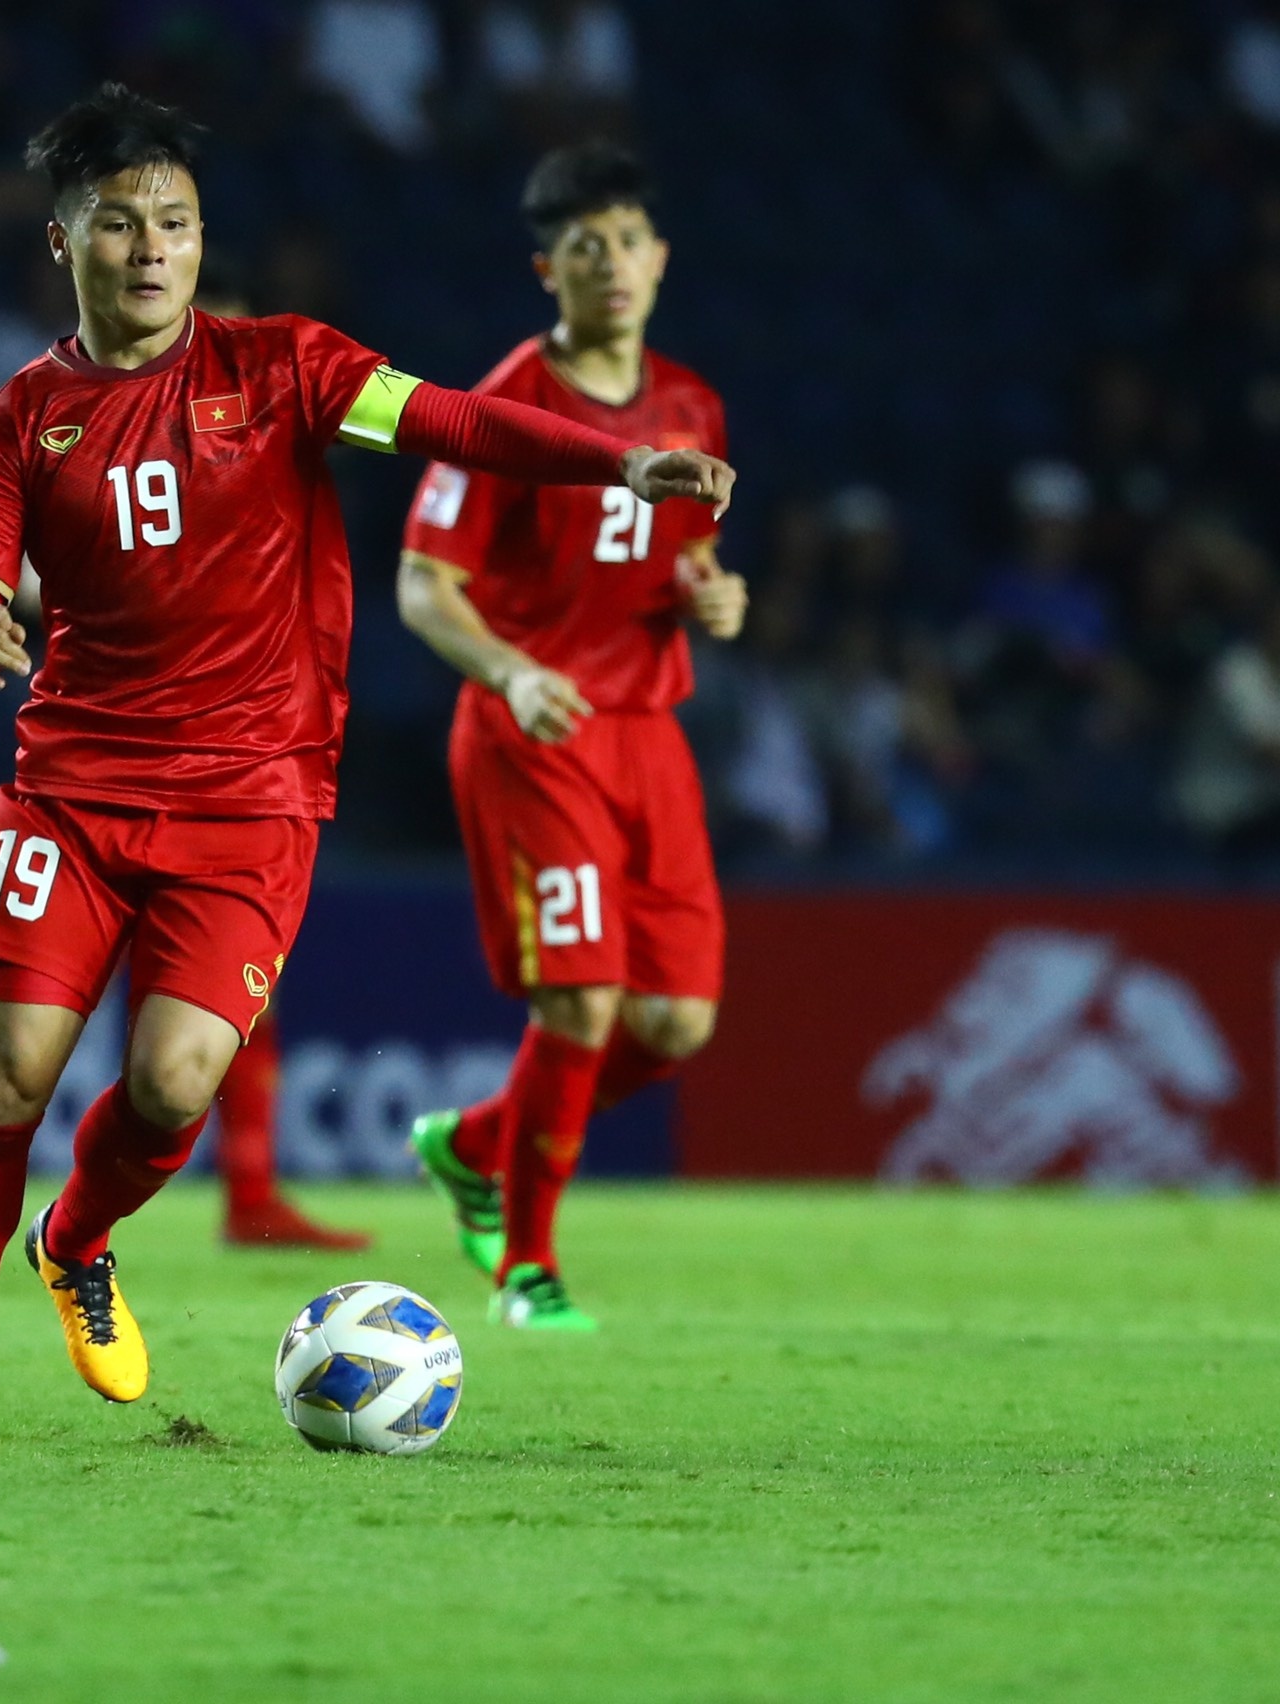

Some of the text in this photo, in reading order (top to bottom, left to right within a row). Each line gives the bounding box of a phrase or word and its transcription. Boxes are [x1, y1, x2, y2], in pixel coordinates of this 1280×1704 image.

[107, 459, 183, 551] 19
[593, 486, 653, 563] 21
[537, 864, 603, 946] 21
